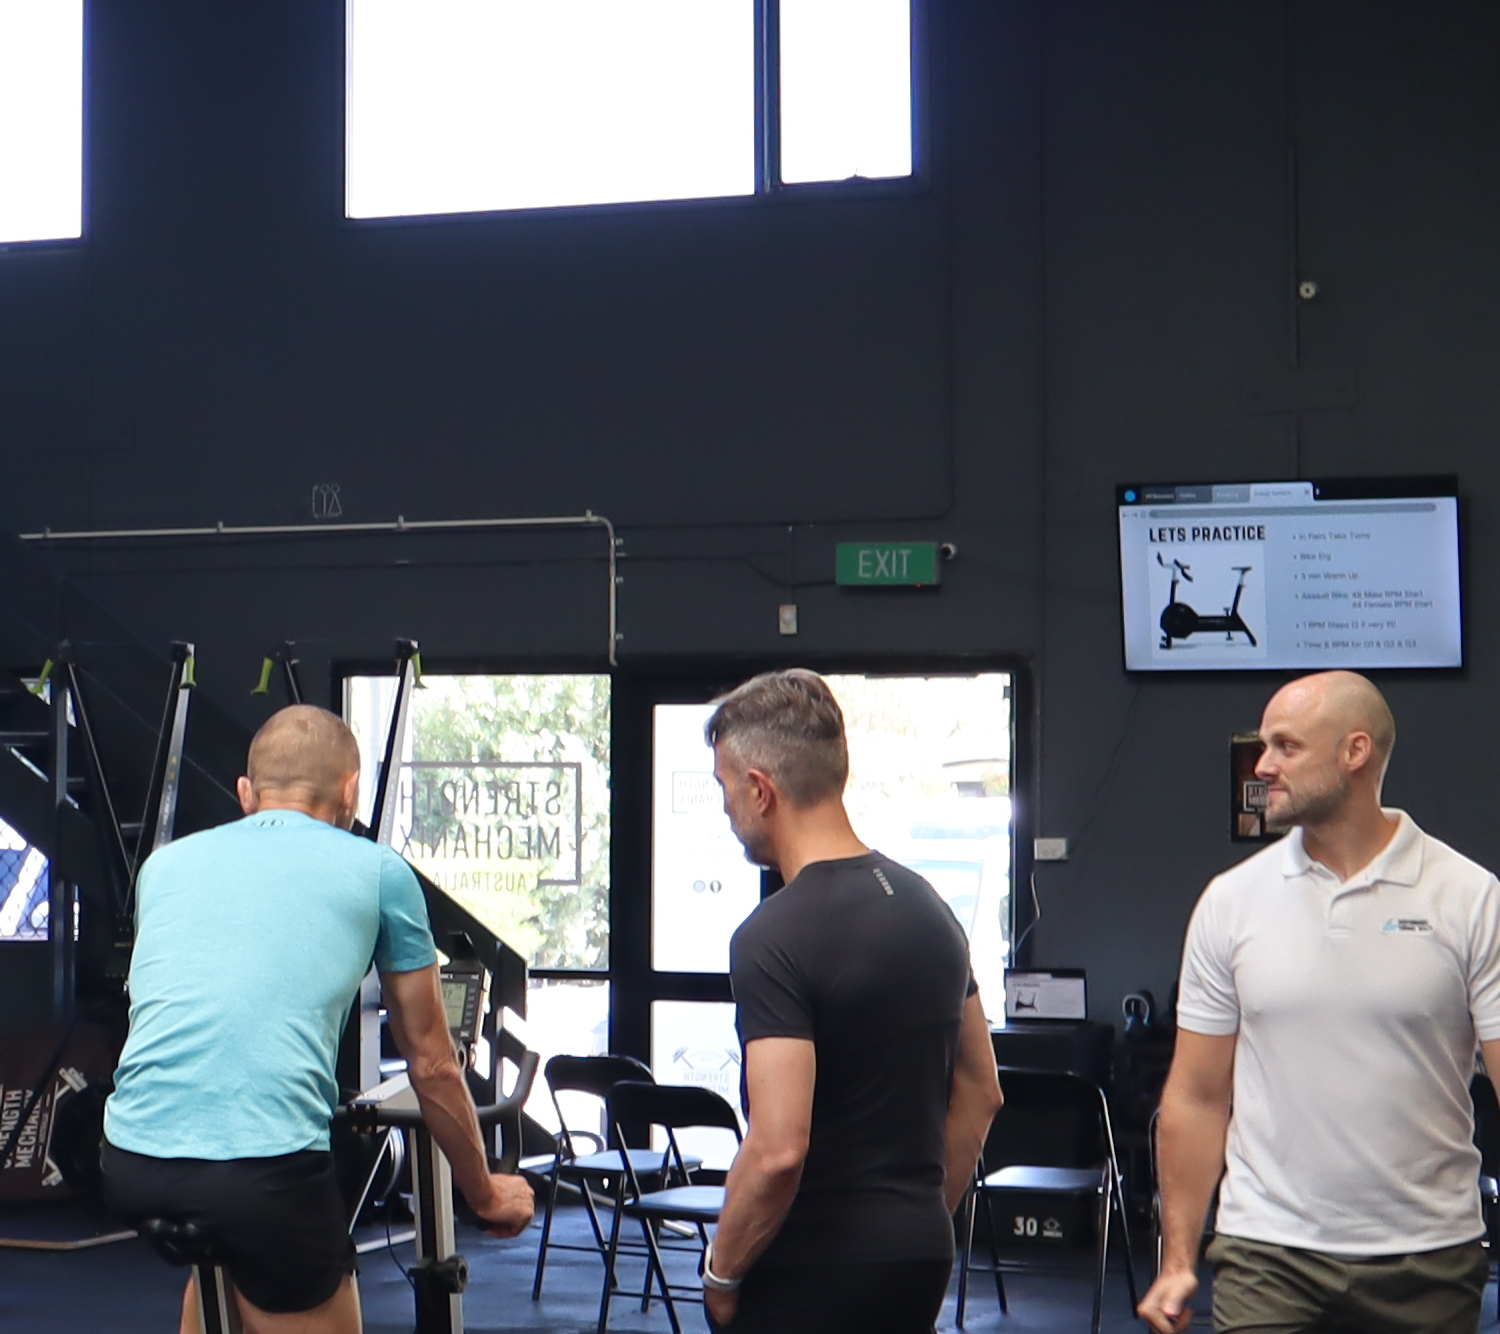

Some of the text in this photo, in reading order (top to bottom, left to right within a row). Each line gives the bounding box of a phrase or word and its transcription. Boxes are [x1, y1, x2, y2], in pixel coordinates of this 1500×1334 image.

[1149, 525, 1266, 543] LETS PRACTICE
[858, 549, 912, 578] EXIT
